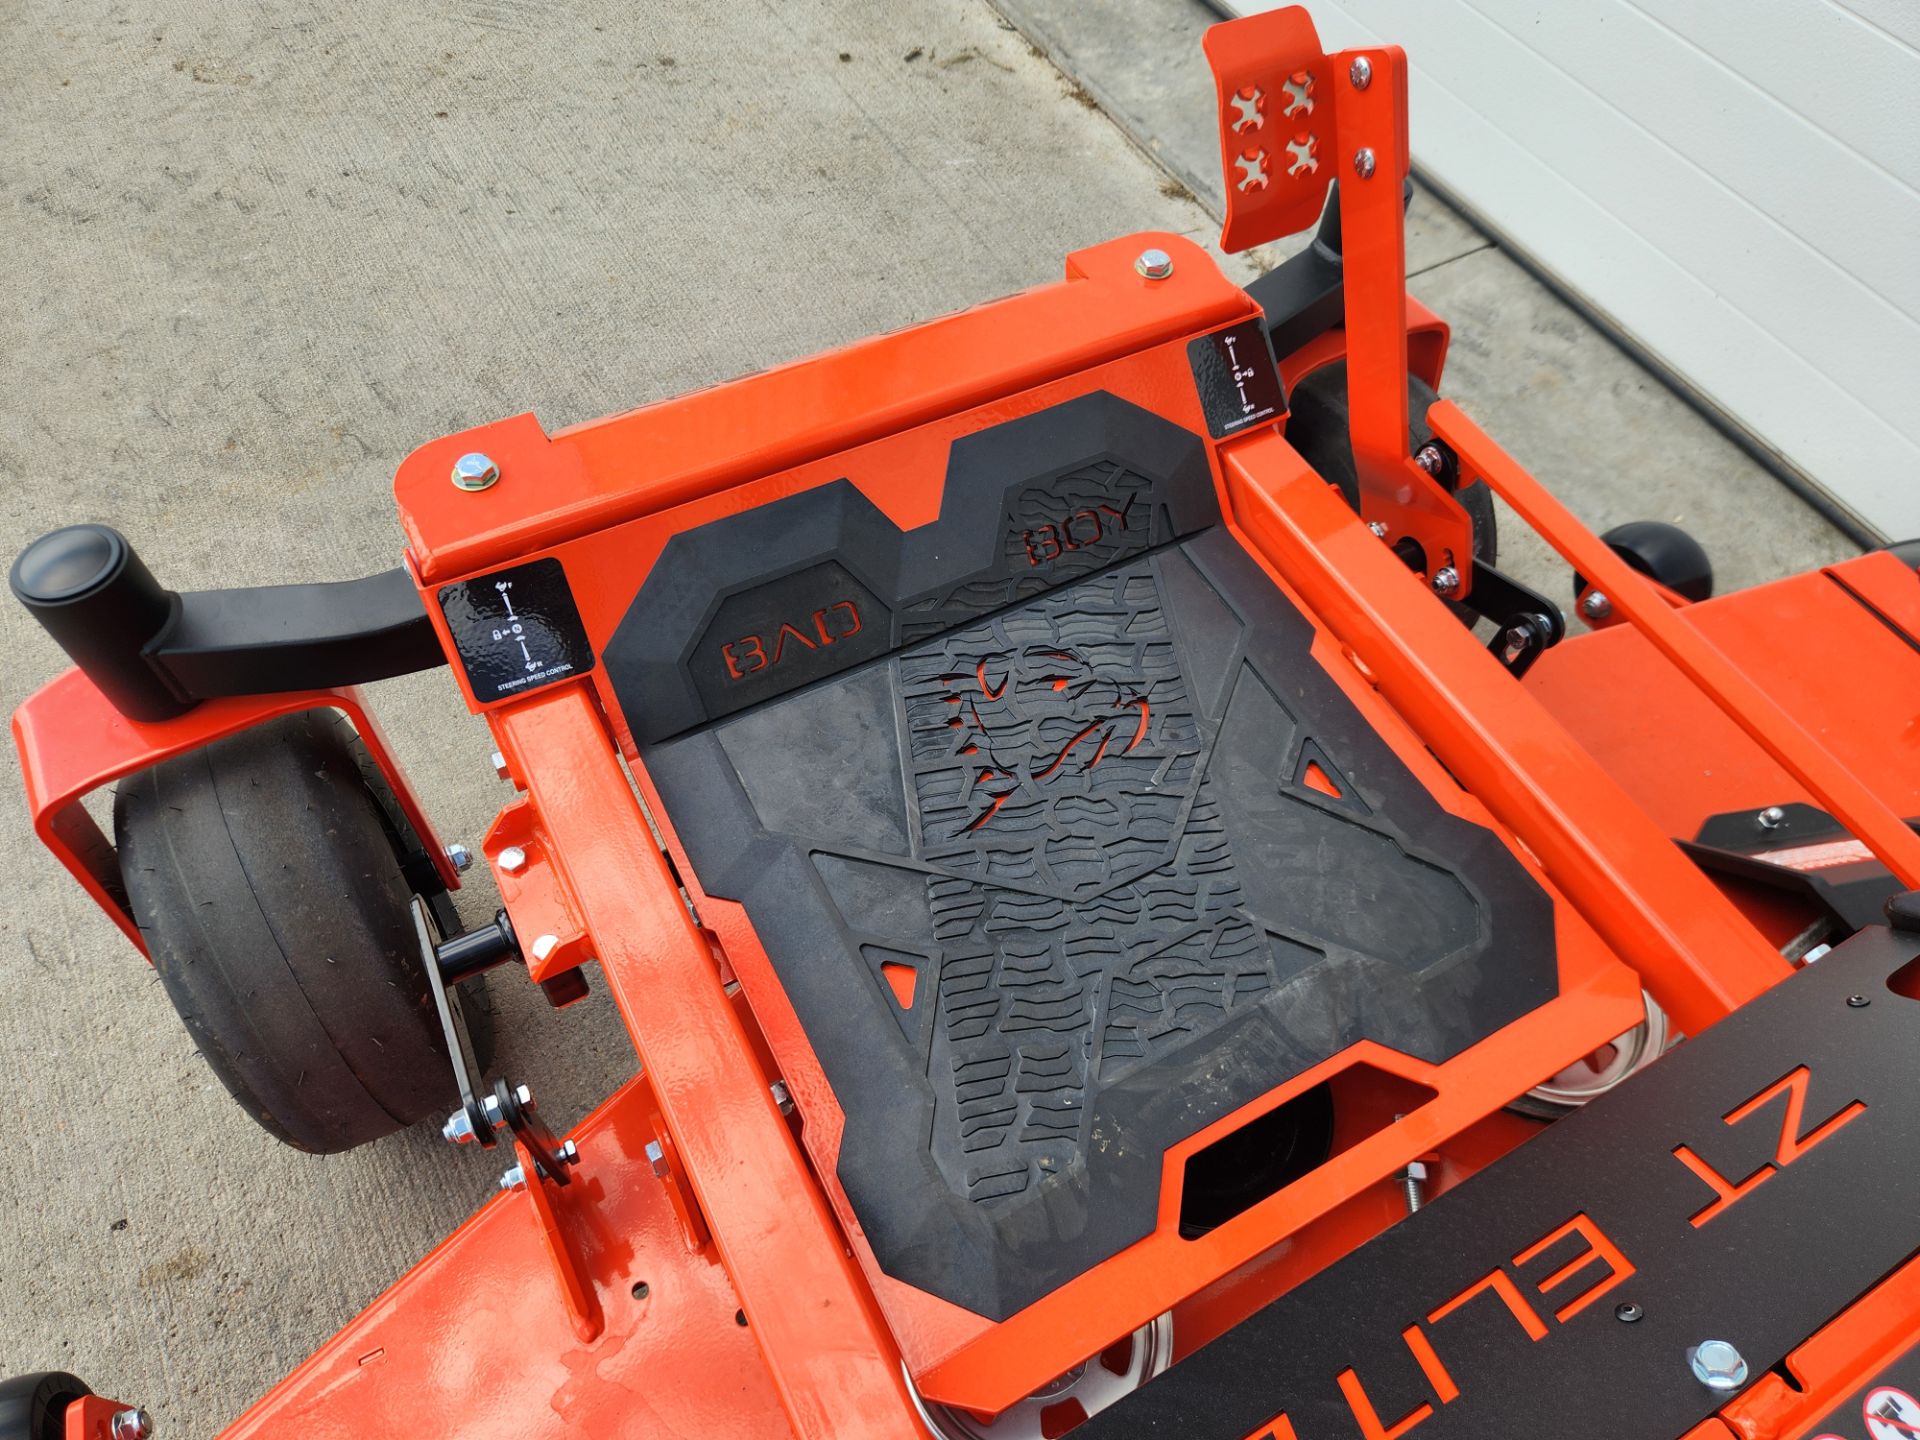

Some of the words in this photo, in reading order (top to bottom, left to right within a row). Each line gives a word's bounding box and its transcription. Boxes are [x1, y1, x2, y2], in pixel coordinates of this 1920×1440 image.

[1022, 492, 1138, 567] BOY
[497, 678, 527, 691] STEERING
[527, 672, 546, 682] SPEED
[546, 664, 573, 676] CONTROL
[720, 600, 863, 681] BAD
